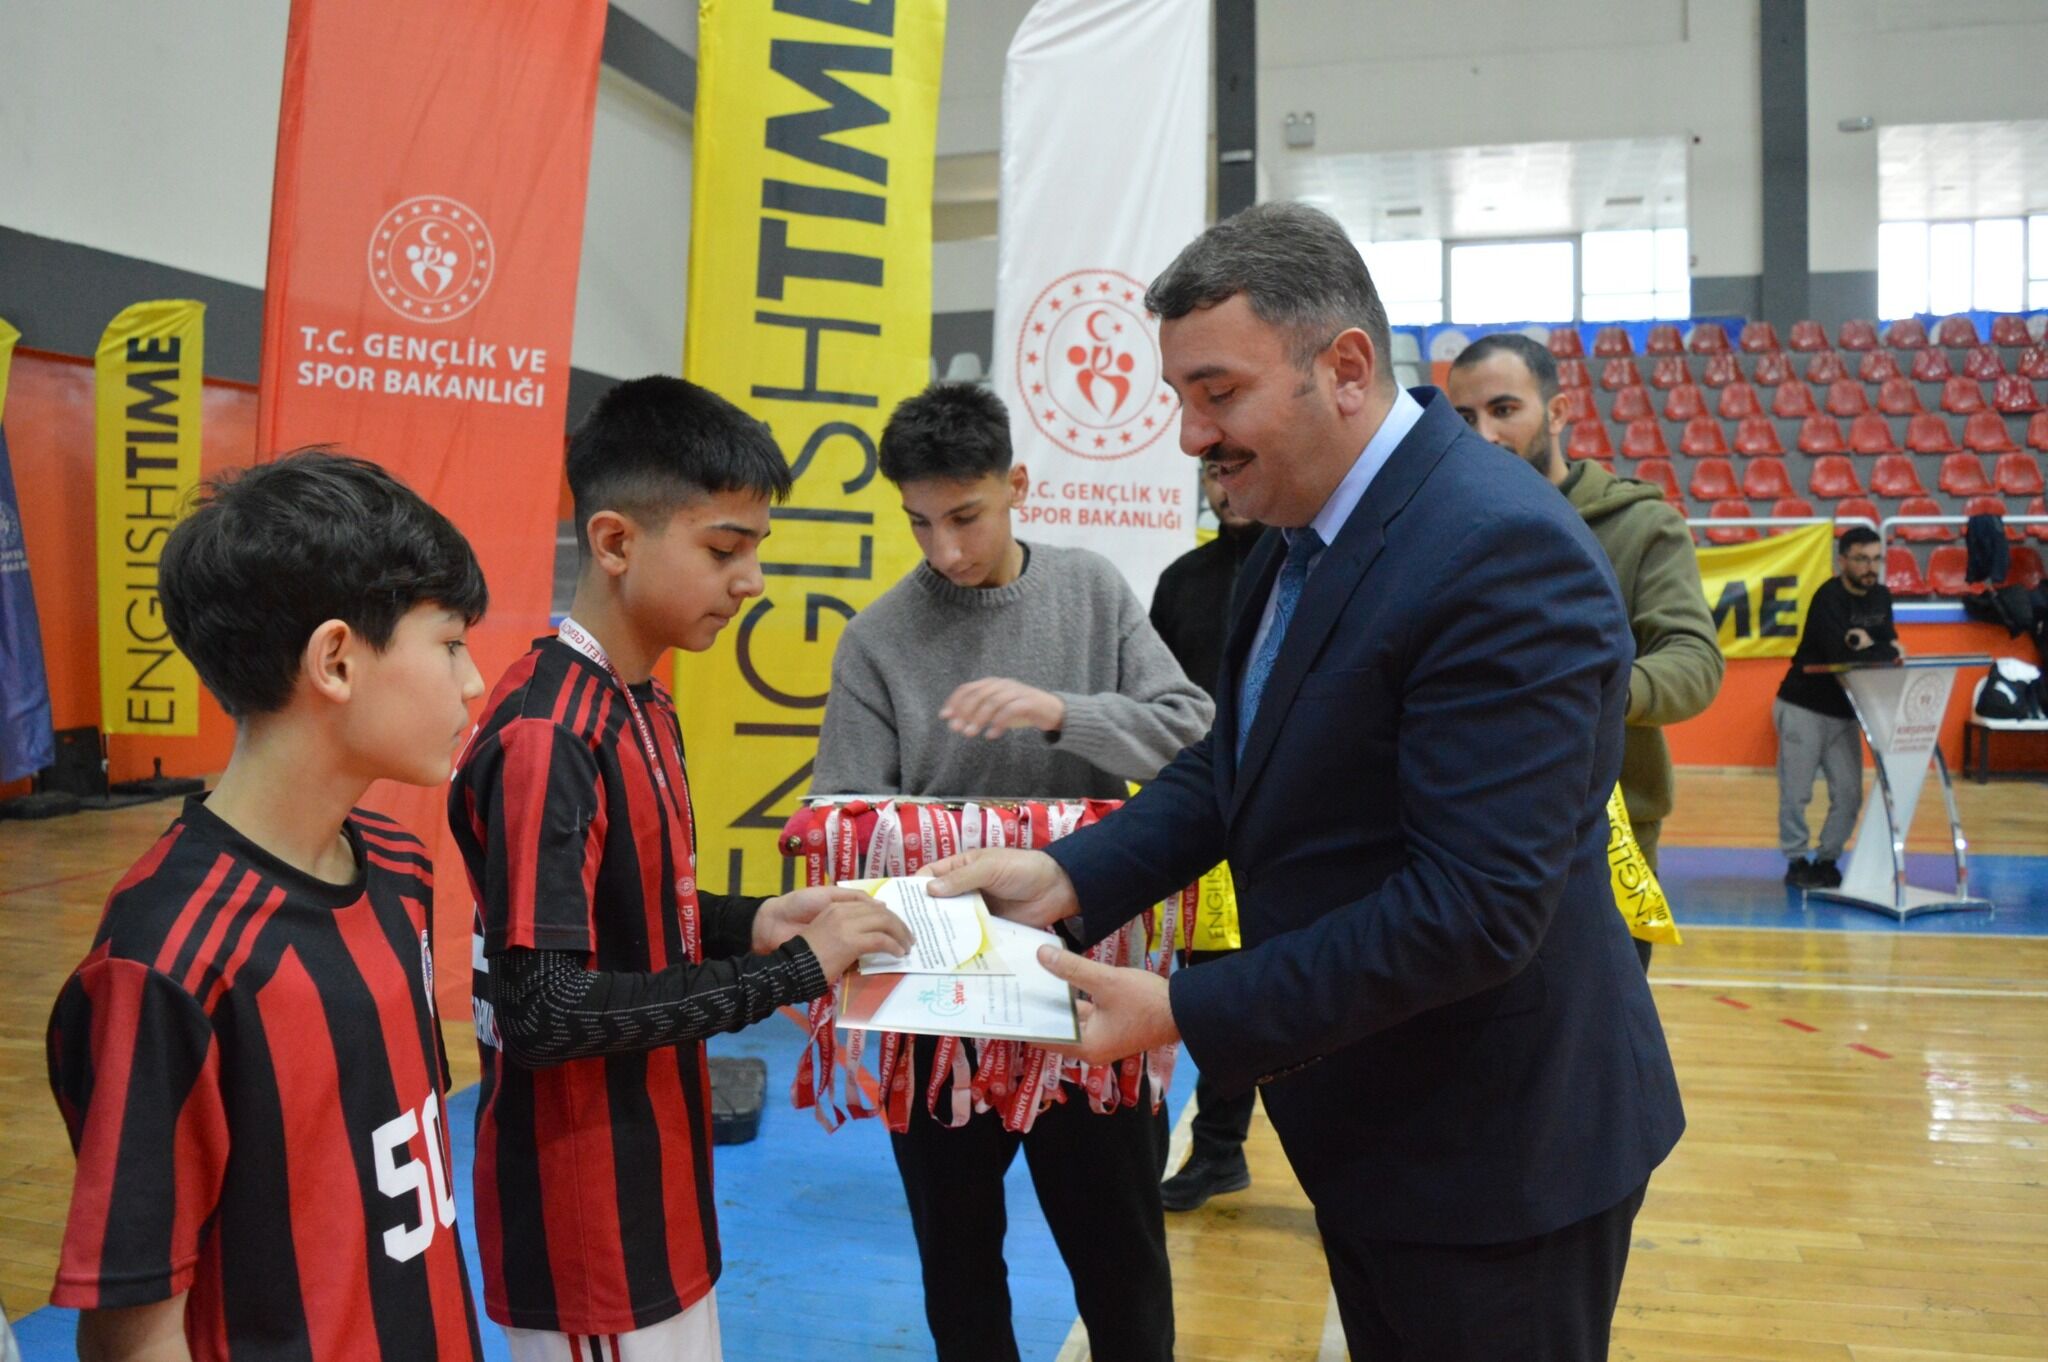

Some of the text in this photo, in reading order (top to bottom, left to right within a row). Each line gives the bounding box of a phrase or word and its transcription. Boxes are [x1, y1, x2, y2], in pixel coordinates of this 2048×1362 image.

[300, 325, 547, 373] T.C. GENÇLİK VE
[297, 361, 545, 408] SPOR BAKANLIĞI
[1030, 481, 1182, 506] .C. GENÇLİK VE
[1018, 506, 1182, 530] SPOR BAKANLIĞI
